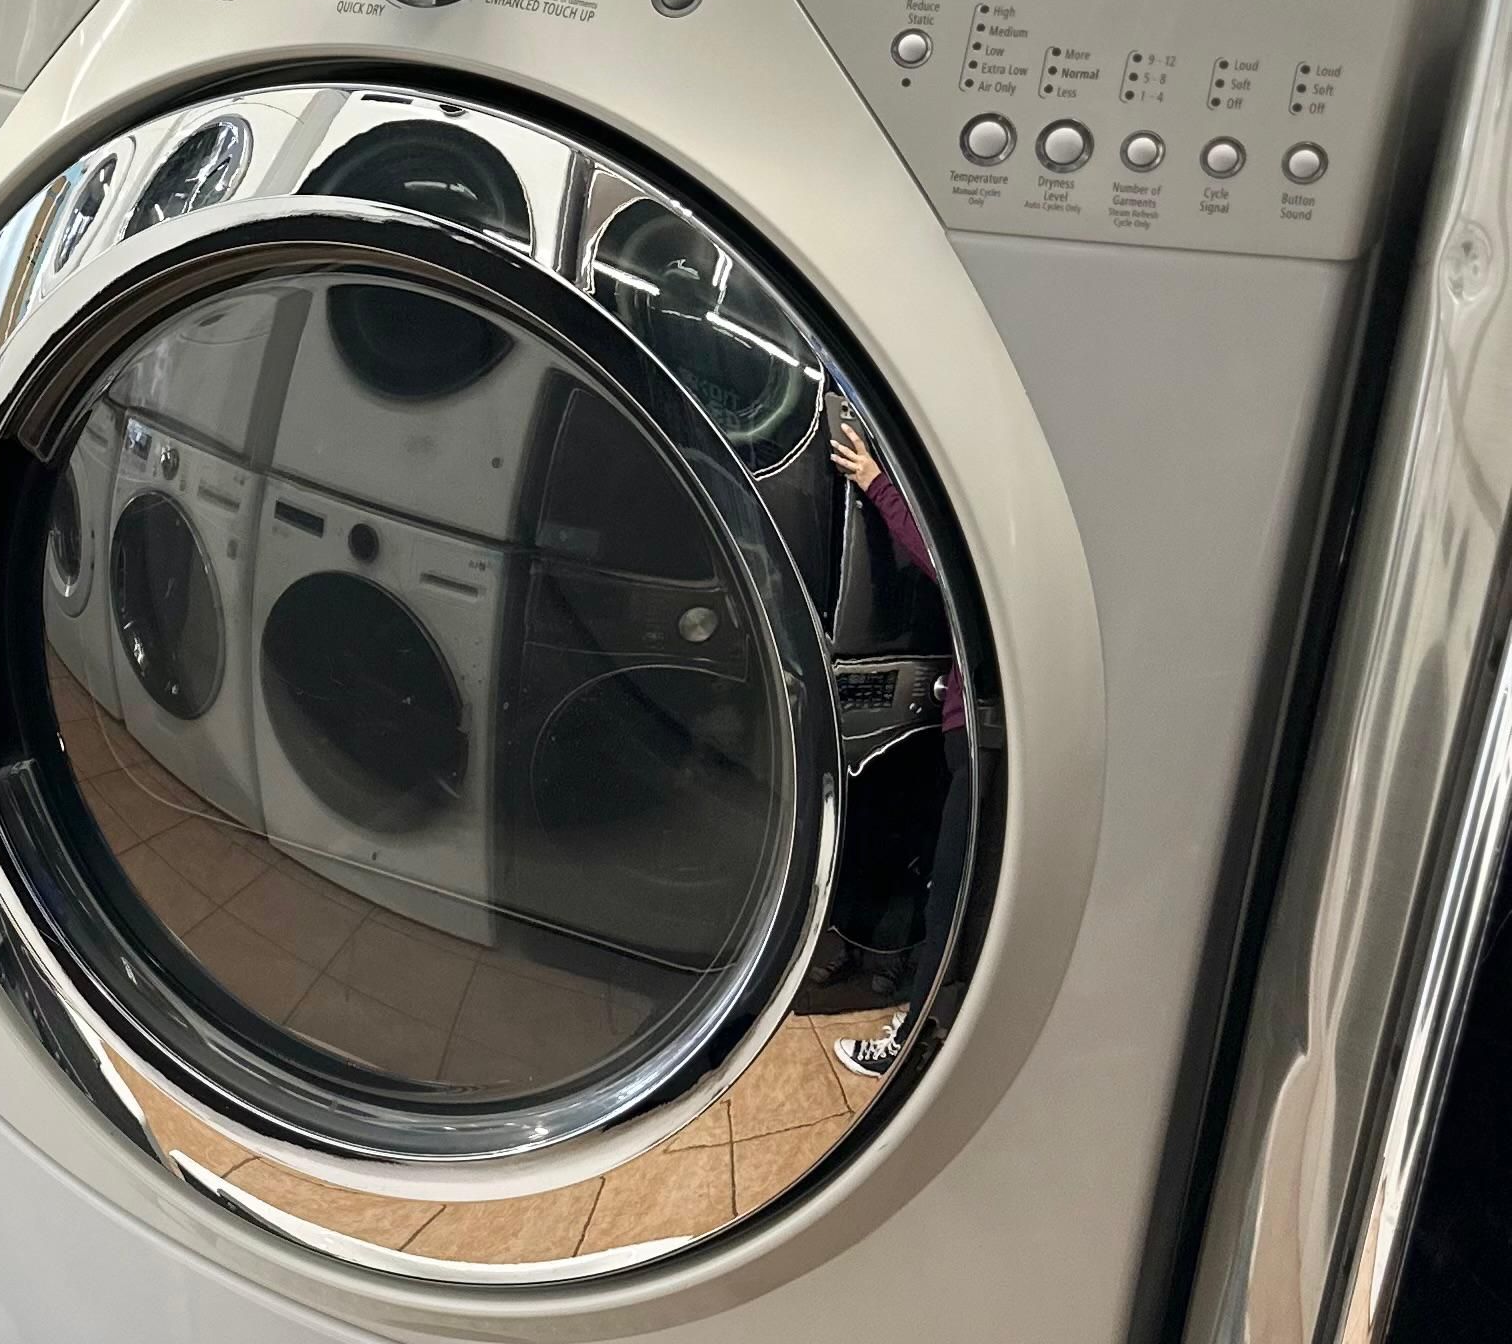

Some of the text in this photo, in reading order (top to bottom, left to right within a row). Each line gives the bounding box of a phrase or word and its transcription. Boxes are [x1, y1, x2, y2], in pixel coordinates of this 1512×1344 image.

[336, 0, 385, 17] QUICK DRY
[542, 1, 577, 20] TOUCH
[579, 9, 595, 23] UP
[906, 0, 941, 12] Reduce
[993, 5, 1016, 20] High
[908, 13, 935, 26] Static
[989, 25, 1029, 38] Medium
[985, 44, 1005, 57] Low
[1065, 48, 1091, 61] More
[981, 62, 1028, 76] Extra Low
[1234, 59, 1259, 72] Loud
[1315, 65, 1342, 78] Loud
[1061, 67, 1100, 80] Normal
[977, 80, 1017, 96] Air Only
[1231, 78, 1251, 91] Soft
[1312, 84, 1334, 97] Soft
[1057, 86, 1077, 98] Less
[1226, 98, 1243, 110] Off
[1309, 102, 1325, 115] Off
[949, 170, 1009, 186] Temperature
[1038, 176, 1075, 191] Dryness
[1112, 182, 1162, 196] Number of
[1203, 187, 1229, 201] Cycle
[968, 196, 984, 207] Only
[1043, 190, 1068, 202] Level
[1112, 195, 1157, 209] Garments
[1281, 192, 1316, 207] Button
[1199, 201, 1230, 216] Signal
[1280, 207, 1313, 221] Sound
